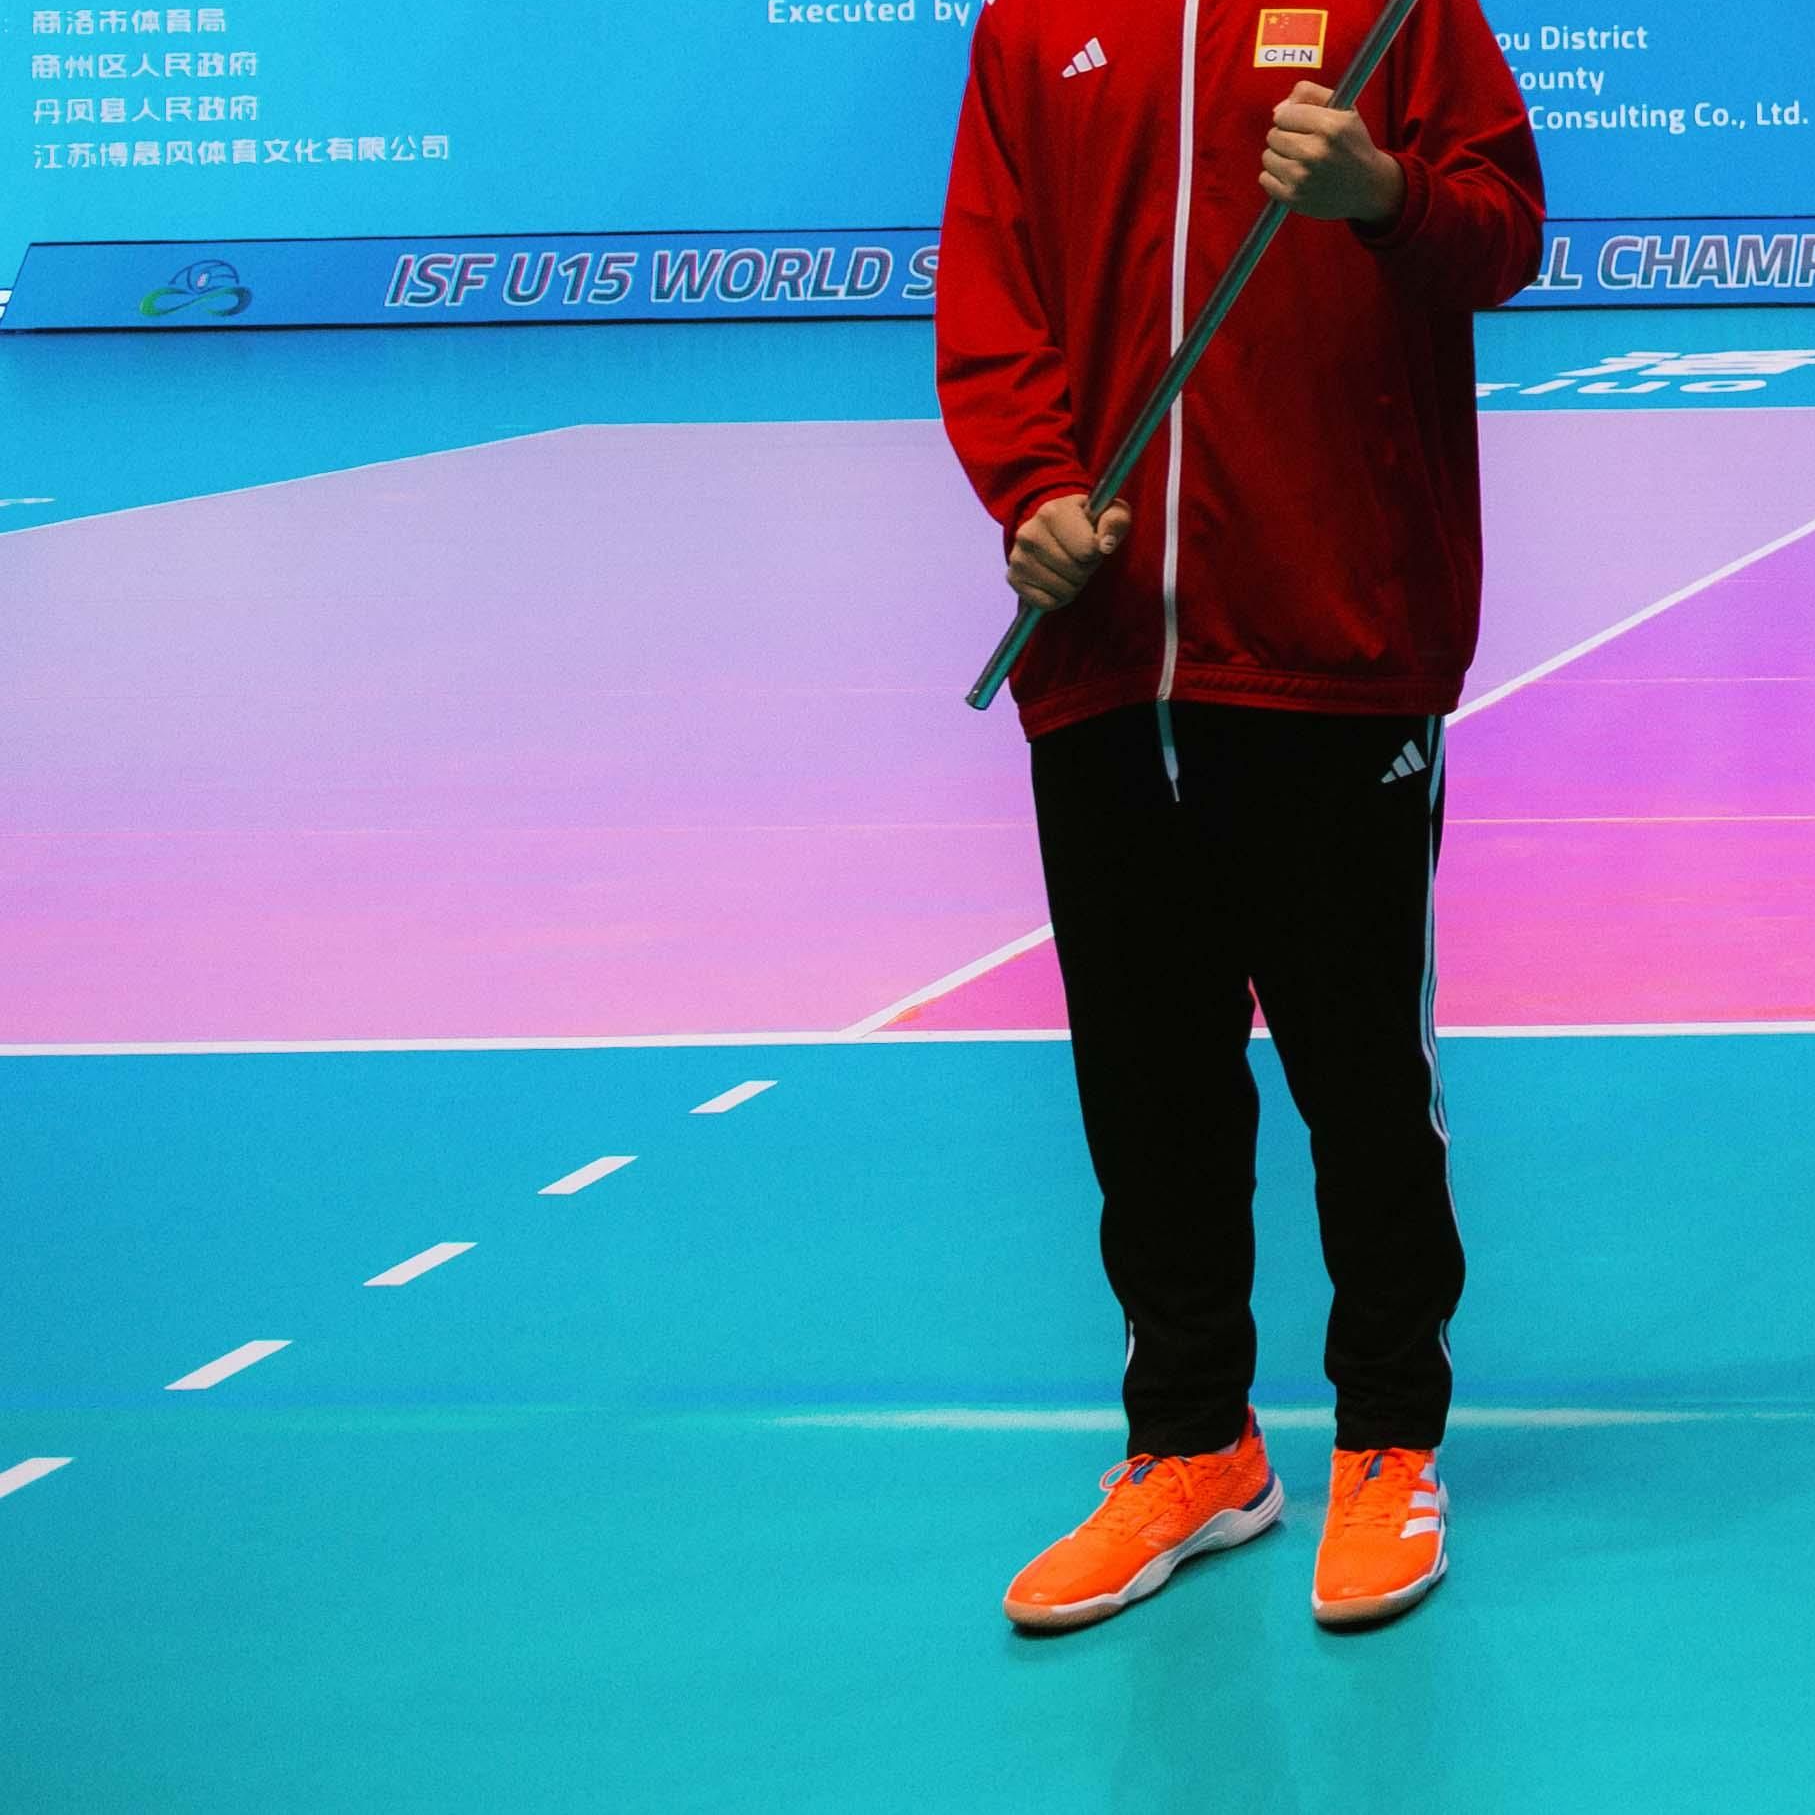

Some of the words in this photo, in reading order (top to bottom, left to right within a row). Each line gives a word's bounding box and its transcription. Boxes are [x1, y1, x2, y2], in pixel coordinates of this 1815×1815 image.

[31, 7, 227, 35] 商洛市体育局
[1540, 24, 1649, 51] District
[31, 50, 259, 80] 商州区人民政府
[1264, 49, 1313, 63] CHN
[1510, 65, 1606, 96] ounty
[1527, 102, 1687, 135] Consulting
[1693, 101, 1747, 130] Co.,
[1756, 99, 1809, 126] Ltd.
[384, 251, 496, 308] ISF
[502, 250, 639, 304] U15
[650, 245, 894, 303] WORLD
